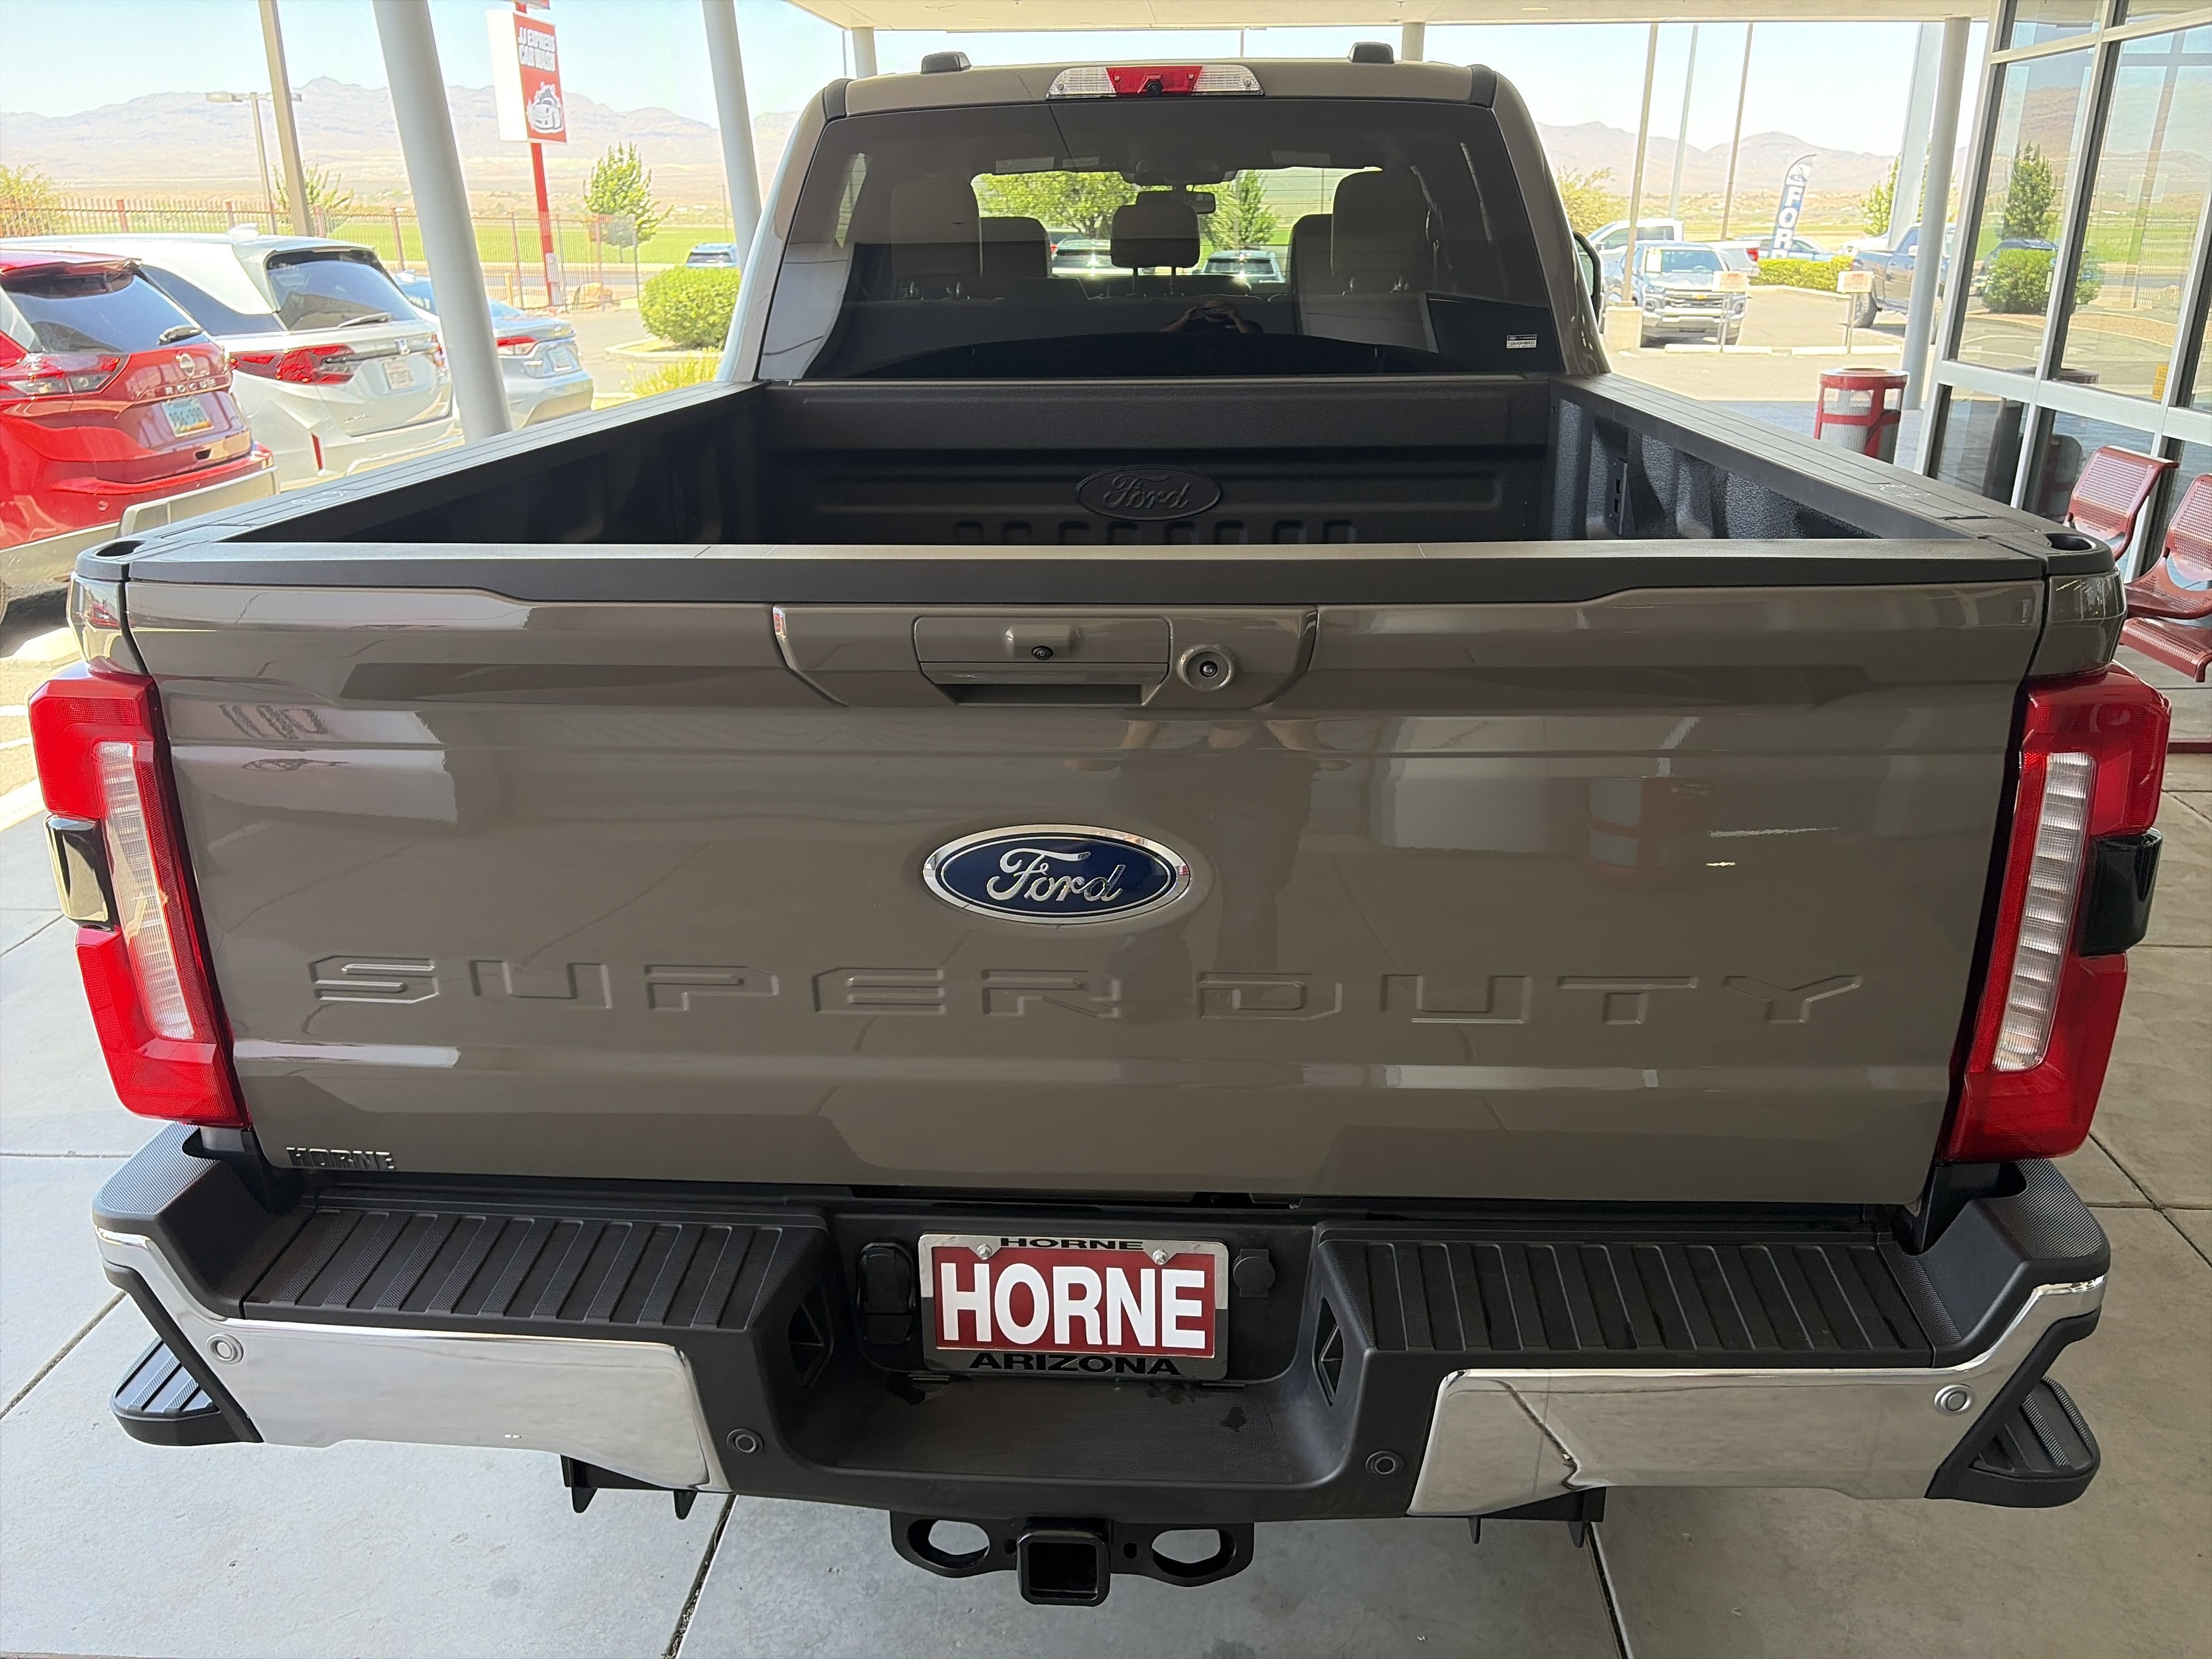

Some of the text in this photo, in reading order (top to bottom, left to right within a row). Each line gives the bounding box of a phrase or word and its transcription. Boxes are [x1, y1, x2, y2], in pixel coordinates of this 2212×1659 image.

[1103, 473, 1192, 510] Ford
[986, 848, 1127, 902] Ford
[308, 955, 1863, 1025] SUPER DUTY
[286, 1147, 396, 1170] HORNE
[1000, 1237, 1144, 1251] HORNE
[940, 1262, 1205, 1350] HORNE
[969, 1352, 1181, 1375] ARIZONA
